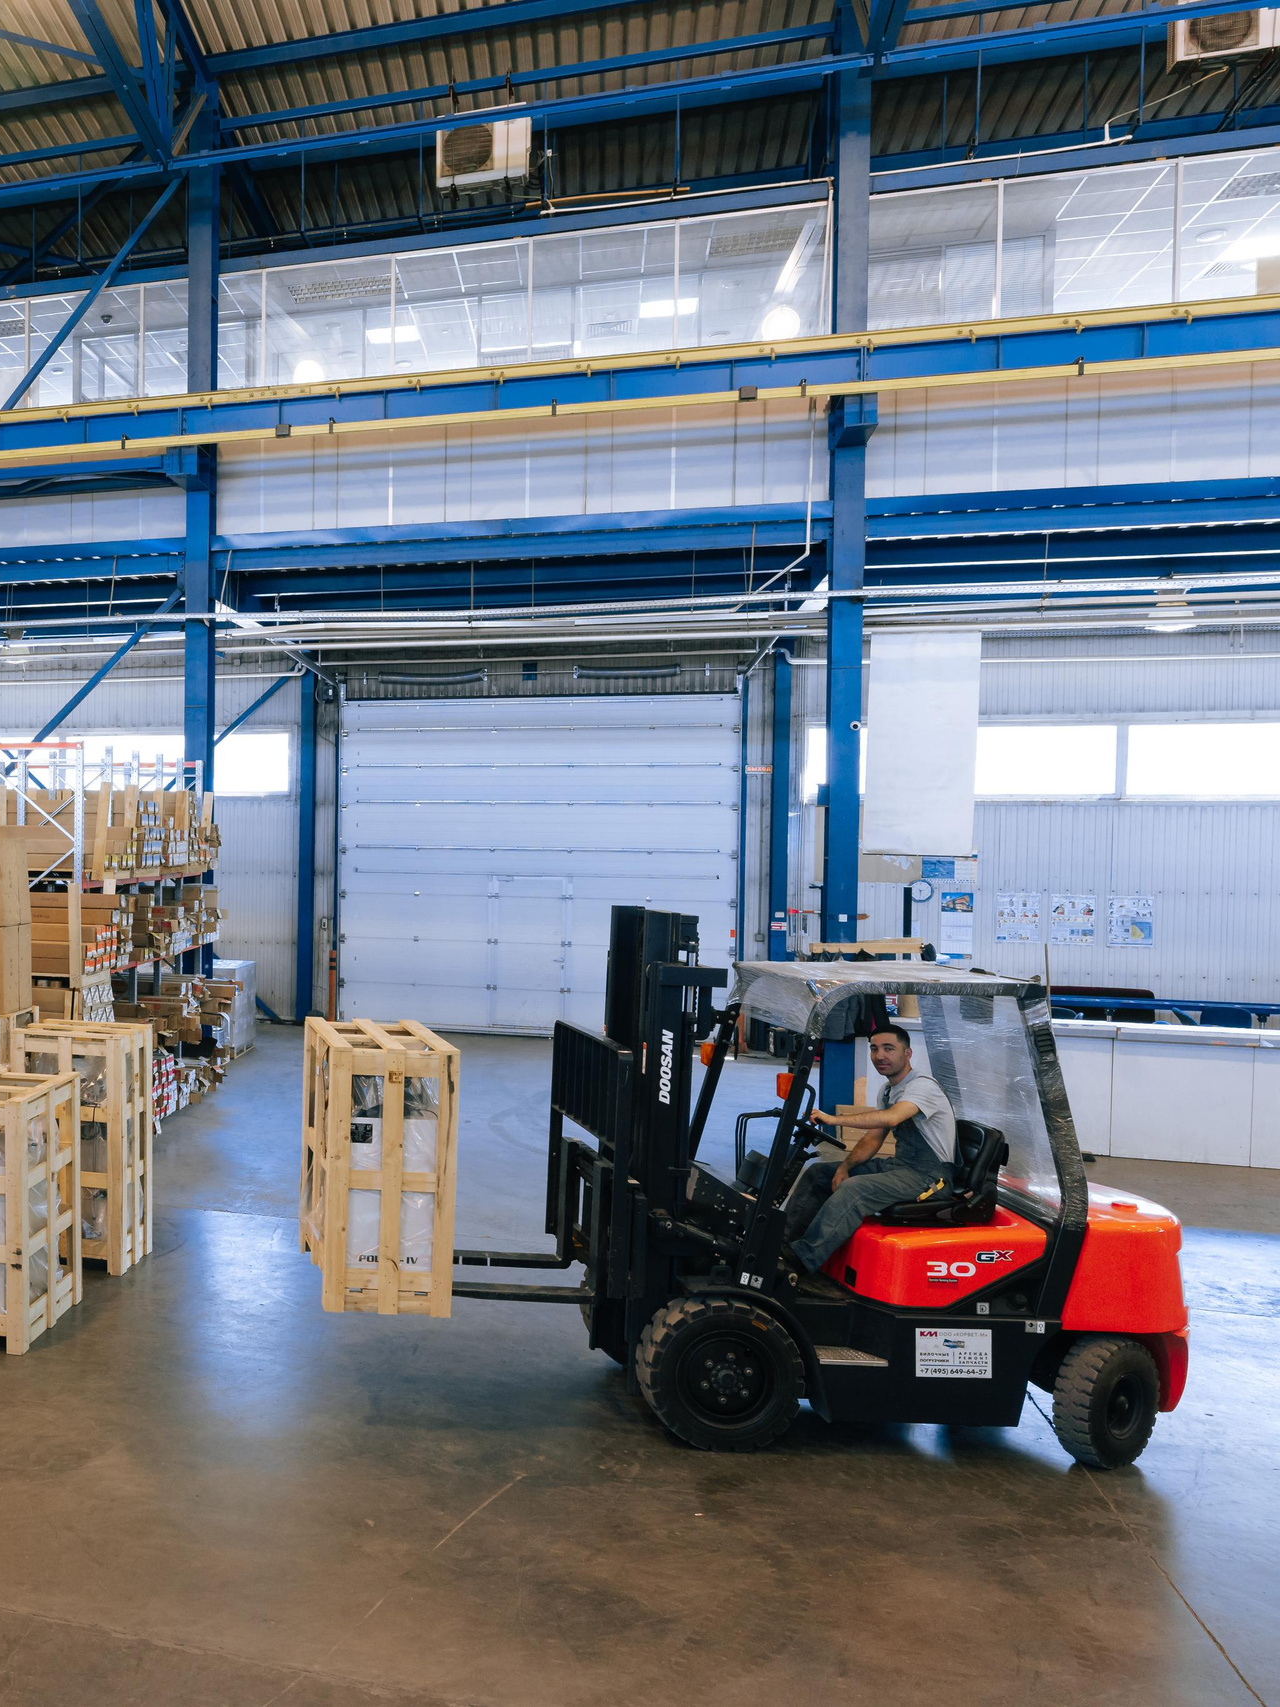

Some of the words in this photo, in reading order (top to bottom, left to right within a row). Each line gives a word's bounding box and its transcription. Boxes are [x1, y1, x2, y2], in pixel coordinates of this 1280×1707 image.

[659, 1029, 674, 1105] DOOSAN
[926, 1261, 977, 1277] 30
[975, 1250, 1015, 1263] GX
